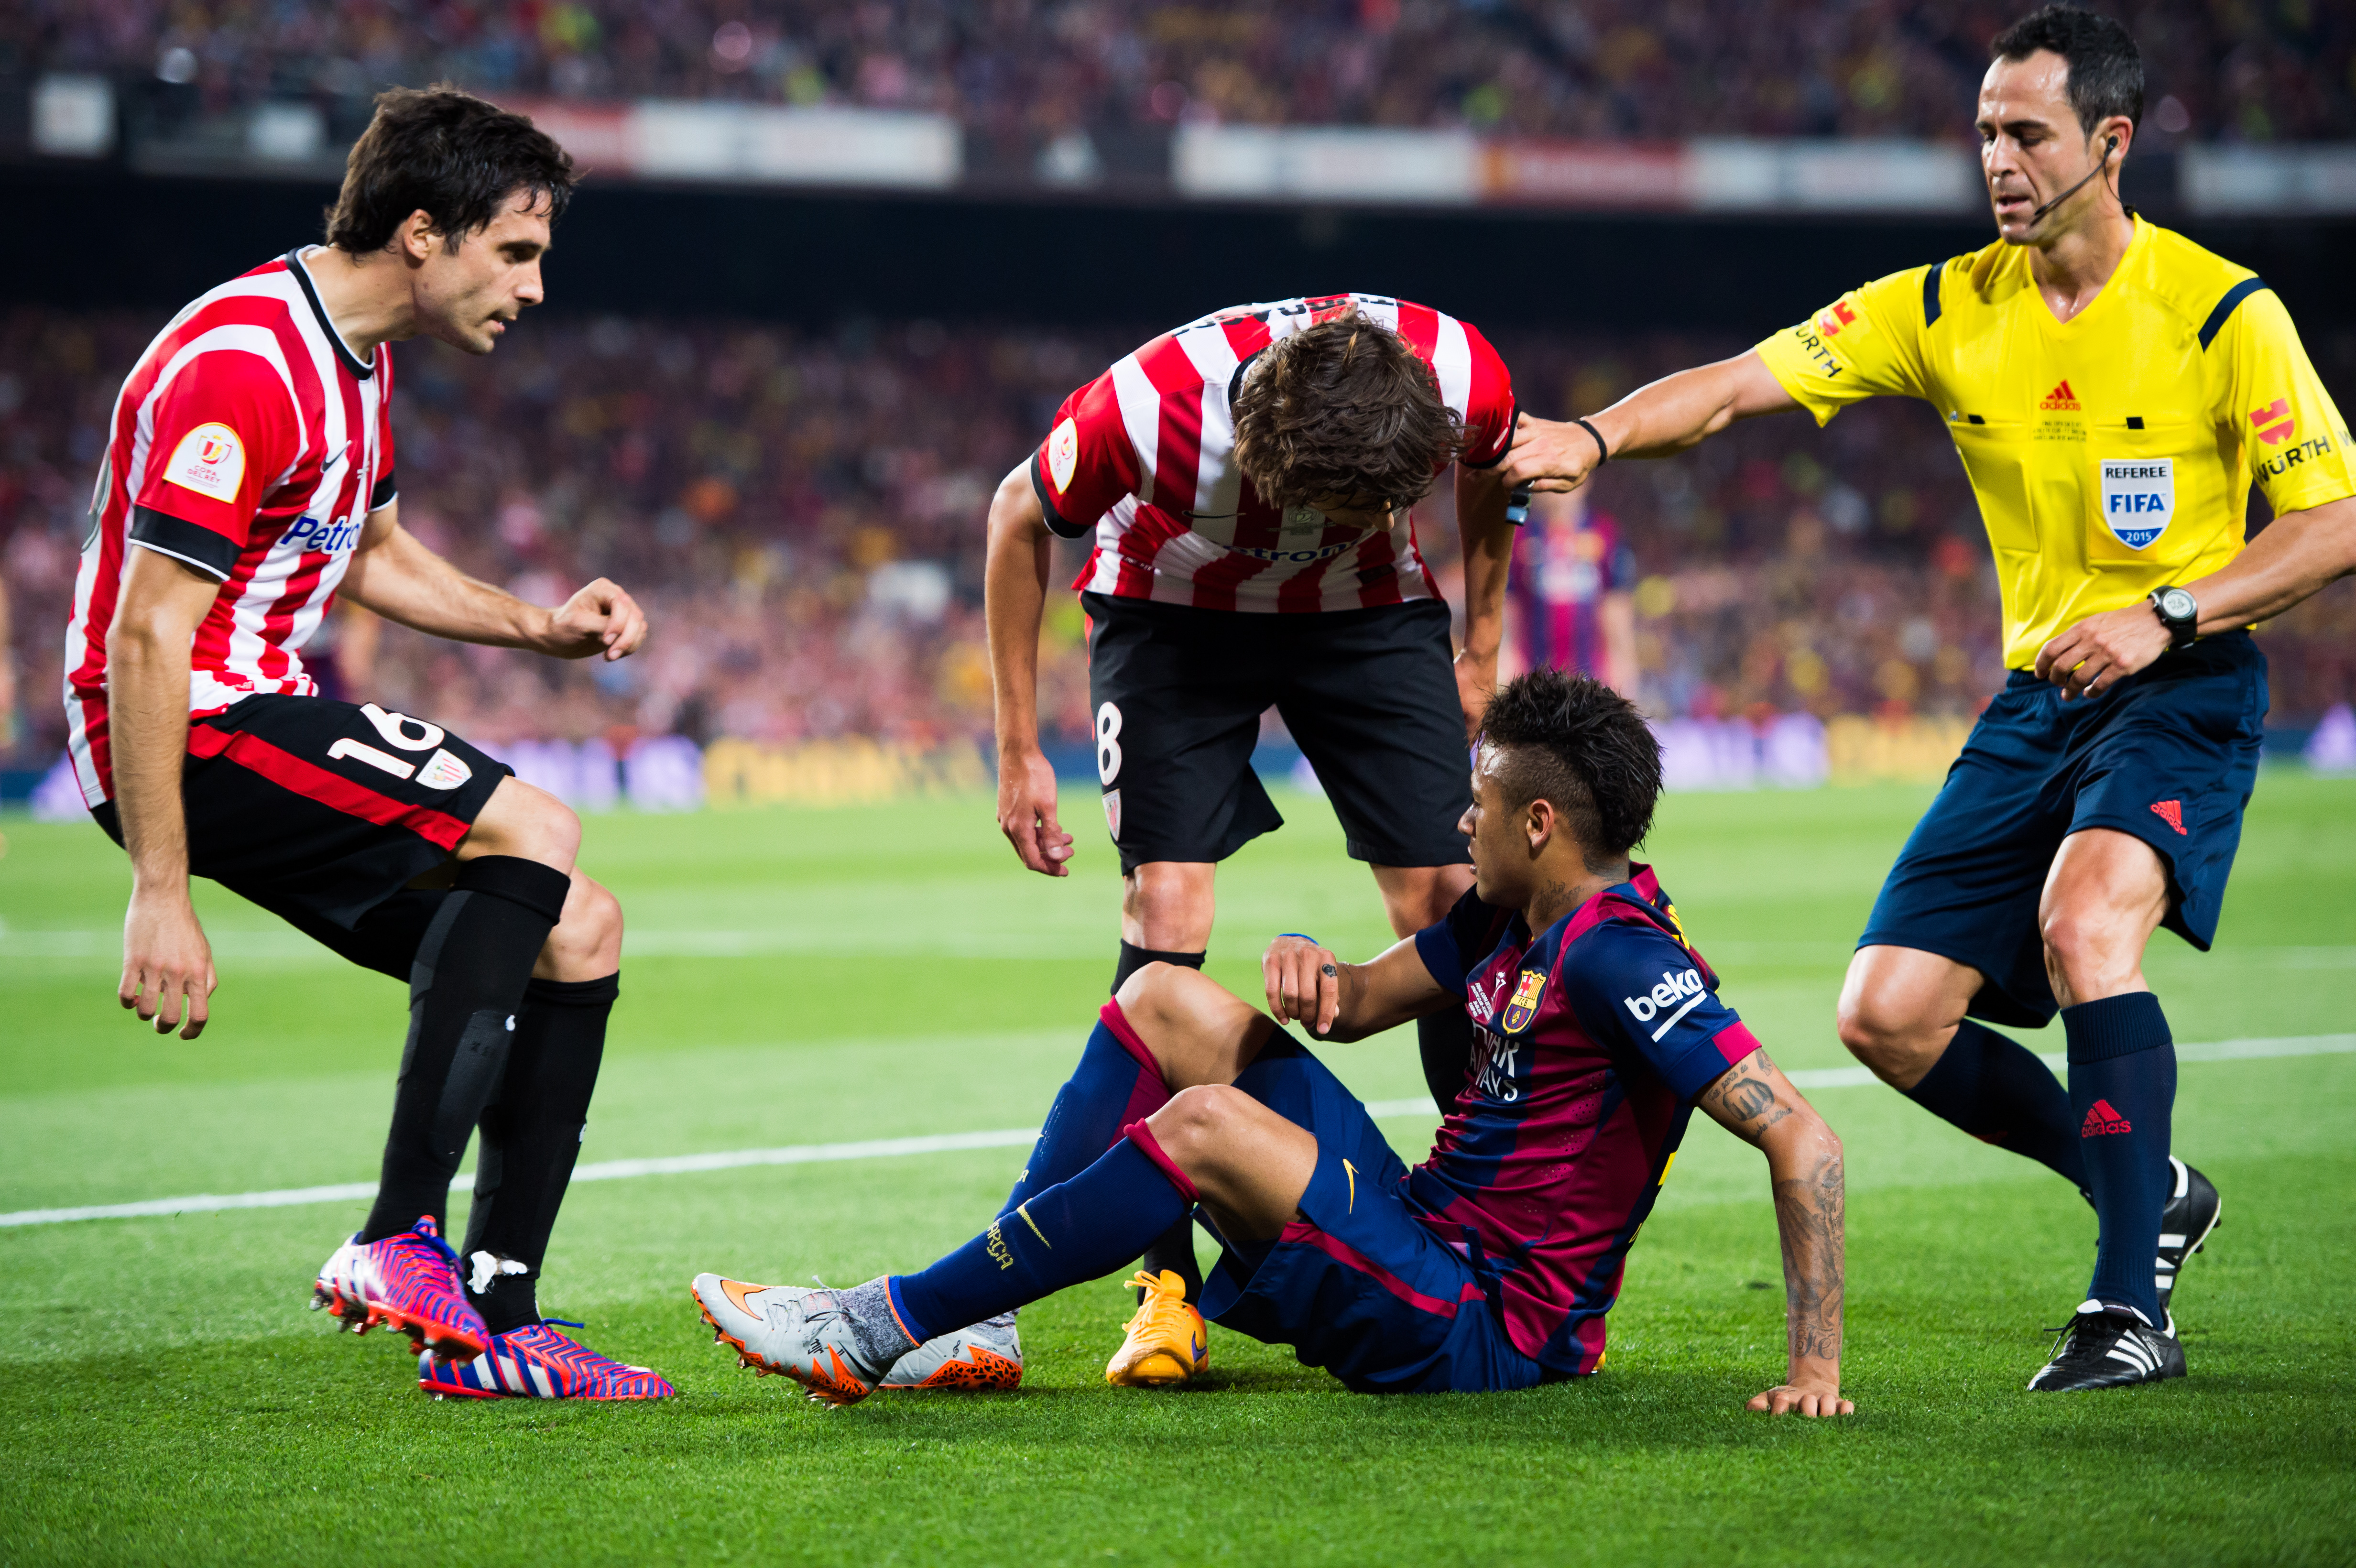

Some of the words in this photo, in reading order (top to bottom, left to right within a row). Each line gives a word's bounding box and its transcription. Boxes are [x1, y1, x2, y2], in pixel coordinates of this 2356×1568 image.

[2257, 436, 2331, 485] WÜRTH
[187, 468, 202, 479] DEL
[195, 465, 217, 476] COPA
[2105, 467, 2168, 478] REFEREE
[2110, 494, 2165, 513] FIFA
[2126, 531, 2152, 542] 2015
[327, 703, 445, 780] 16
[1097, 701, 1123, 786] 8
[1624, 969, 1703, 1022] beko
[2082, 1120, 2132, 1139] adidas
